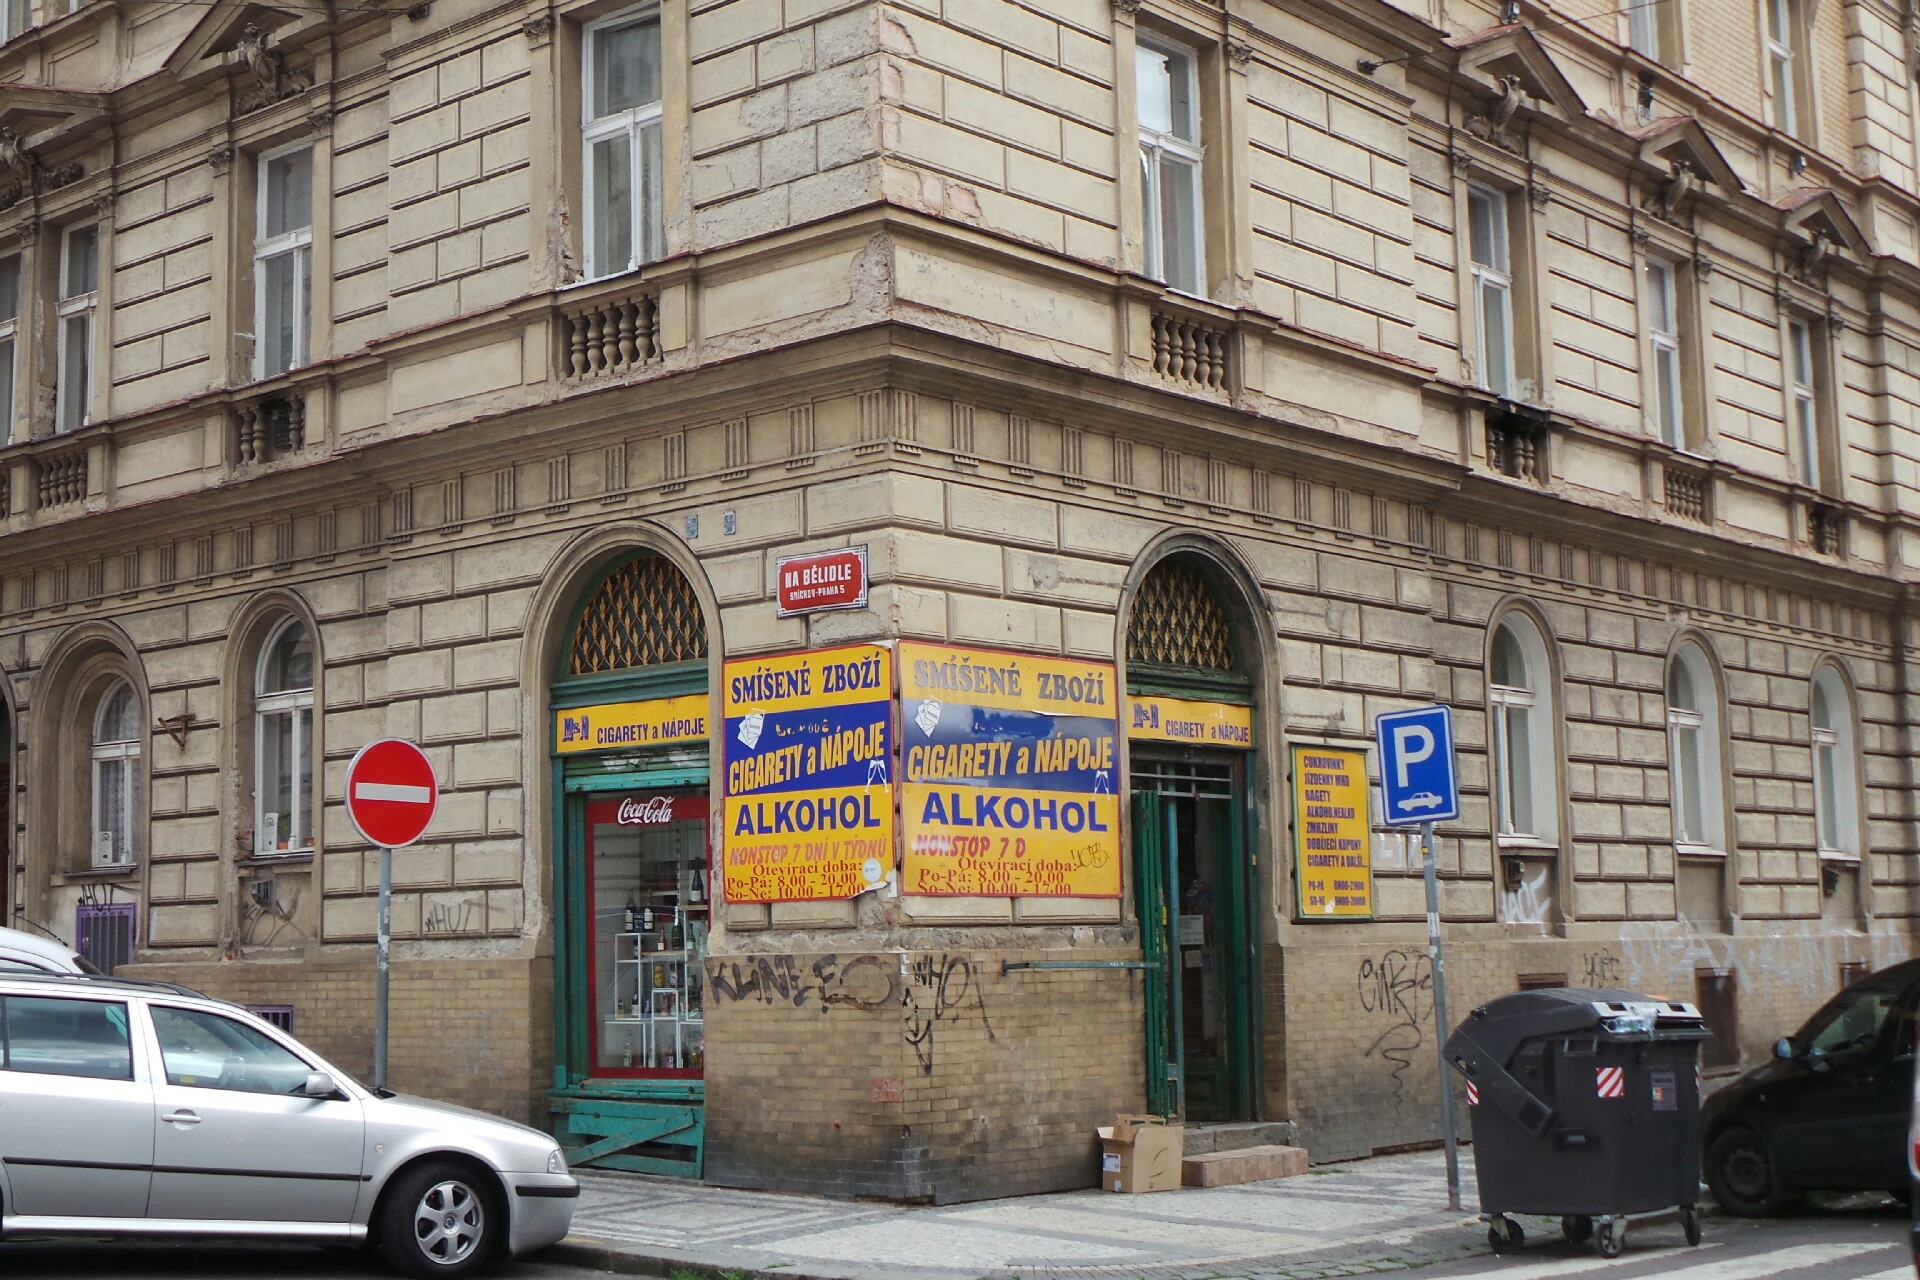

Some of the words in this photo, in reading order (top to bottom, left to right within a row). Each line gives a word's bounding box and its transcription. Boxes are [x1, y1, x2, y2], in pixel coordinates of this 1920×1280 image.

[785, 571, 799, 588] NA
[803, 563, 852, 586] BĚLIDLE
[840, 584, 845, 594] 5
[731, 660, 811, 704] SMÍŠENÉ
[822, 651, 881, 694] ZBOŽÍ
[914, 655, 1022, 697] SMÍŠENÉ
[1037, 671, 1105, 706] ZBOŽÍ
[597, 723, 648, 744] CIGARETY
[652, 724, 658, 739] a
[662, 717, 705, 738] NÁPOJE
[1165, 719, 1205, 739] CIGARETY
[1211, 726, 1217, 739] a
[1218, 721, 1249, 742] NÁPOJE
[729, 743, 804, 795] CIGARETY
[806, 746, 816, 775] a
[820, 721, 885, 771] NÁPOJE
[907, 741, 1012, 782] CIGARETY
[1015, 746, 1029, 774] a
[1034, 731, 1113, 774] NÁPOJE
[1303, 755, 1345, 770] CUKROVINKY
[1393, 724, 1435, 788] P
[1304, 770, 1334, 786] JÍZDENKY
[1334, 774, 1350, 787] MHD
[1305, 789, 1331, 803] BAGETY
[734, 795, 880, 836] ALKOHOL
[921, 791, 1108, 833] ALKOHOL
[1306, 821, 1339, 834] ZMRZLINY
[730, 844, 789, 866] NONSTOP
[793, 843, 800, 863] 7
[805, 835, 828, 864] DNÍ
[832, 841, 840, 860] V
[913, 834, 991, 858] NONSTOP
[1000, 837, 1009, 858] 7
[1014, 838, 1026, 858] D
[1306, 836, 1337, 850] DOBÍJECÍ
[1338, 839, 1362, 851] KUPONY
[752, 862, 818, 878] Otevírací
[822, 859, 862, 874] doba:
[958, 856, 1031, 872] Otevírací
[1036, 860, 1078, 872] doba:
[1307, 854, 1339, 868] CIGARETY
[1340, 855, 1346, 868] A
[727, 875, 772, 889] Po-Pá:
[777, 874, 806, 889] 8.00
[820, 872, 857, 887] 20.00
[919, 868, 972, 883] Po-Pá:
[978, 871, 1010, 884] 8.00
[1026, 871, 1064, 885] 20.00
[778, 886, 814, 899] 10.00
[979, 882, 1018, 895] 10.00
[1034, 883, 1072, 895] 17.00
